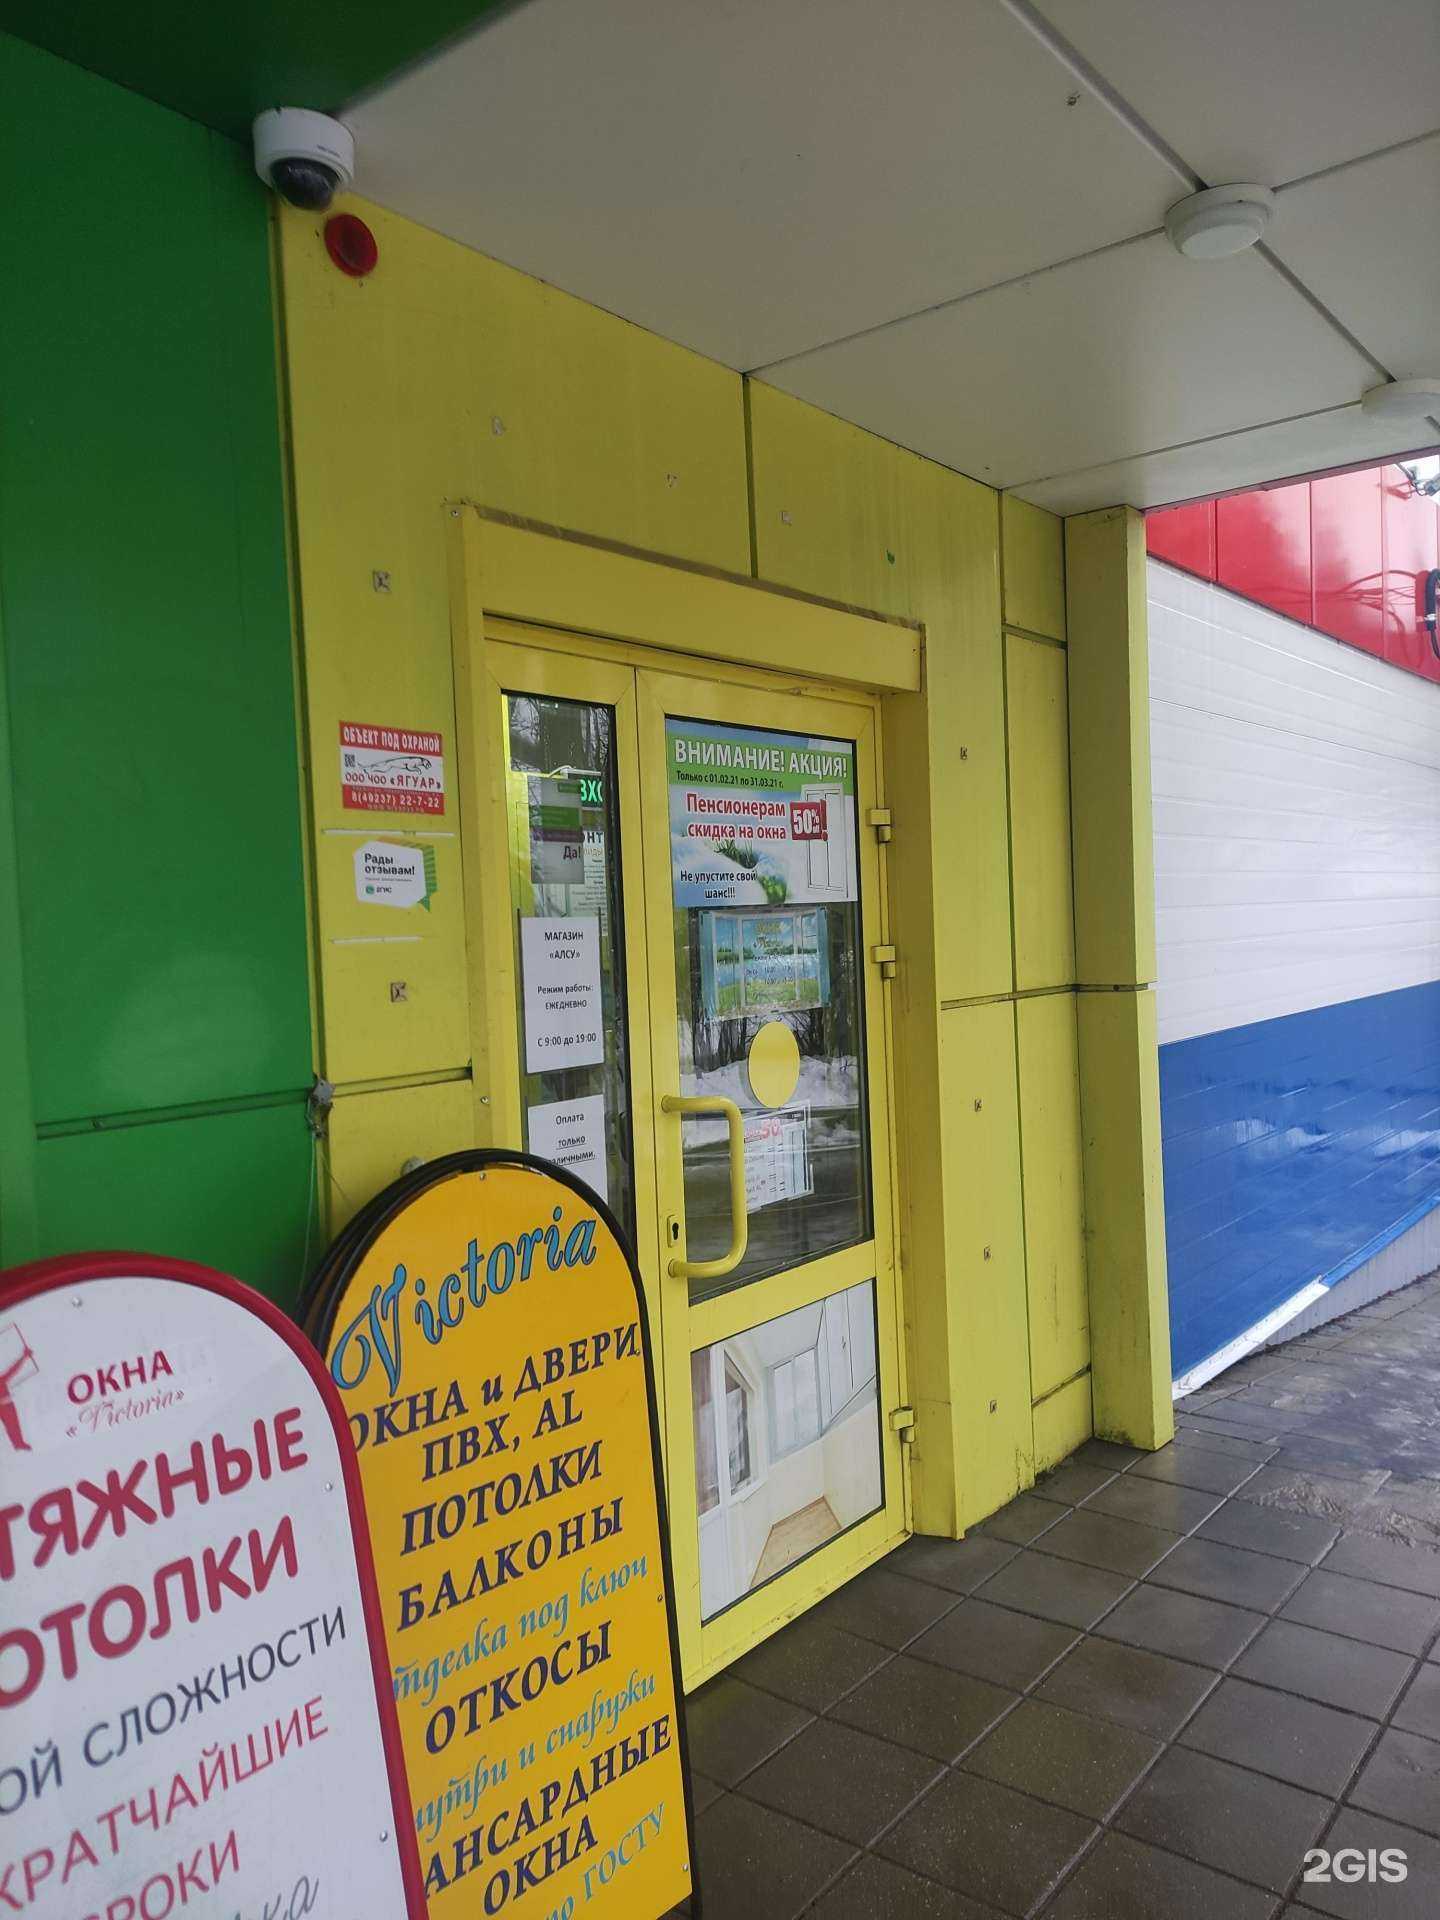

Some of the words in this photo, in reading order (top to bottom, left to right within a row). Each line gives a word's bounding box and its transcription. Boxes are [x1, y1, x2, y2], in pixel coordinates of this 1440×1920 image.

[343, 726, 379, 745] ОБЪЕКТ
[382, 731, 400, 750] ПОД
[402, 734, 440, 752] ОХРАНОЙ
[674, 739, 785, 772] ВНИМАНИЕ!
[789, 753, 847, 780] АКЦИЯ!
[345, 771, 366, 782] ООО
[368, 774, 387, 785] ЧОО
[390, 774, 441, 790] «ЯГУАР»
[677, 770, 703, 782] Только
[709, 773, 738, 785] 01.02.21
[740, 777, 749, 786] по
[750, 776, 777, 788] 31.03.21
[687, 793, 786, 820] Пенсионерам
[688, 822, 735, 842] скидка
[739, 825, 754, 840] на
[757, 826, 786, 841] окна
[364, 852, 394, 865] Рады
[364, 865, 415, 876] отзывам!
[680, 870, 693, 882] Не
[694, 871, 735, 884] упустите
[736, 869, 758, 881] свой
[705, 886, 736, 899] шанс!!!
[544, 931, 584, 941] МАГАЗИН
[549, 949, 581, 959] «АЛСУ»
[537, 985, 564, 995] Режим
[565, 983, 594, 995] работы:
[545, 999, 587, 1011] ЕЖЕДНЕВНО
[545, 1035, 562, 1046] 9:00
[563, 1036, 574, 1048] до
[576, 1032, 597, 1044] 19:00
[555, 1112, 585, 1125] Оплата
[557, 1135, 586, 1149] только
[331, 1206, 597, 1398] Victoria
[67, 1349, 174, 1405] ОКНА
[482, 1374, 504, 1407] и
[513, 1322, 642, 1401] ДВЕРИ
[65, 1389, 185, 1438] «Victoria»
[422, 1412, 521, 1482] ПВХ,
[532, 1388, 584, 1440] AL
[400, 1440, 603, 1556] ПОТОЛКИ
[396, 1496, 624, 1632] БАЛКОНЫ
[393, 1617, 508, 1707] тделка
[518, 1592, 569, 1639] под
[578, 1555, 648, 1609] ключ
[83, 1604, 347, 1768] СЛОЖНОСТИ
[425, 1620, 613, 1755] ОТКОСЫ
[518, 1742, 536, 1771] и
[546, 1668, 656, 1749] снаружи
[424, 1713, 672, 1901] АНСАРДНЫЕ
[483, 1813, 599, 1917] ОКНА
[582, 1801, 665, 1901] ГОСТУ
[82, 1828, 240, 1920] РОКИ
